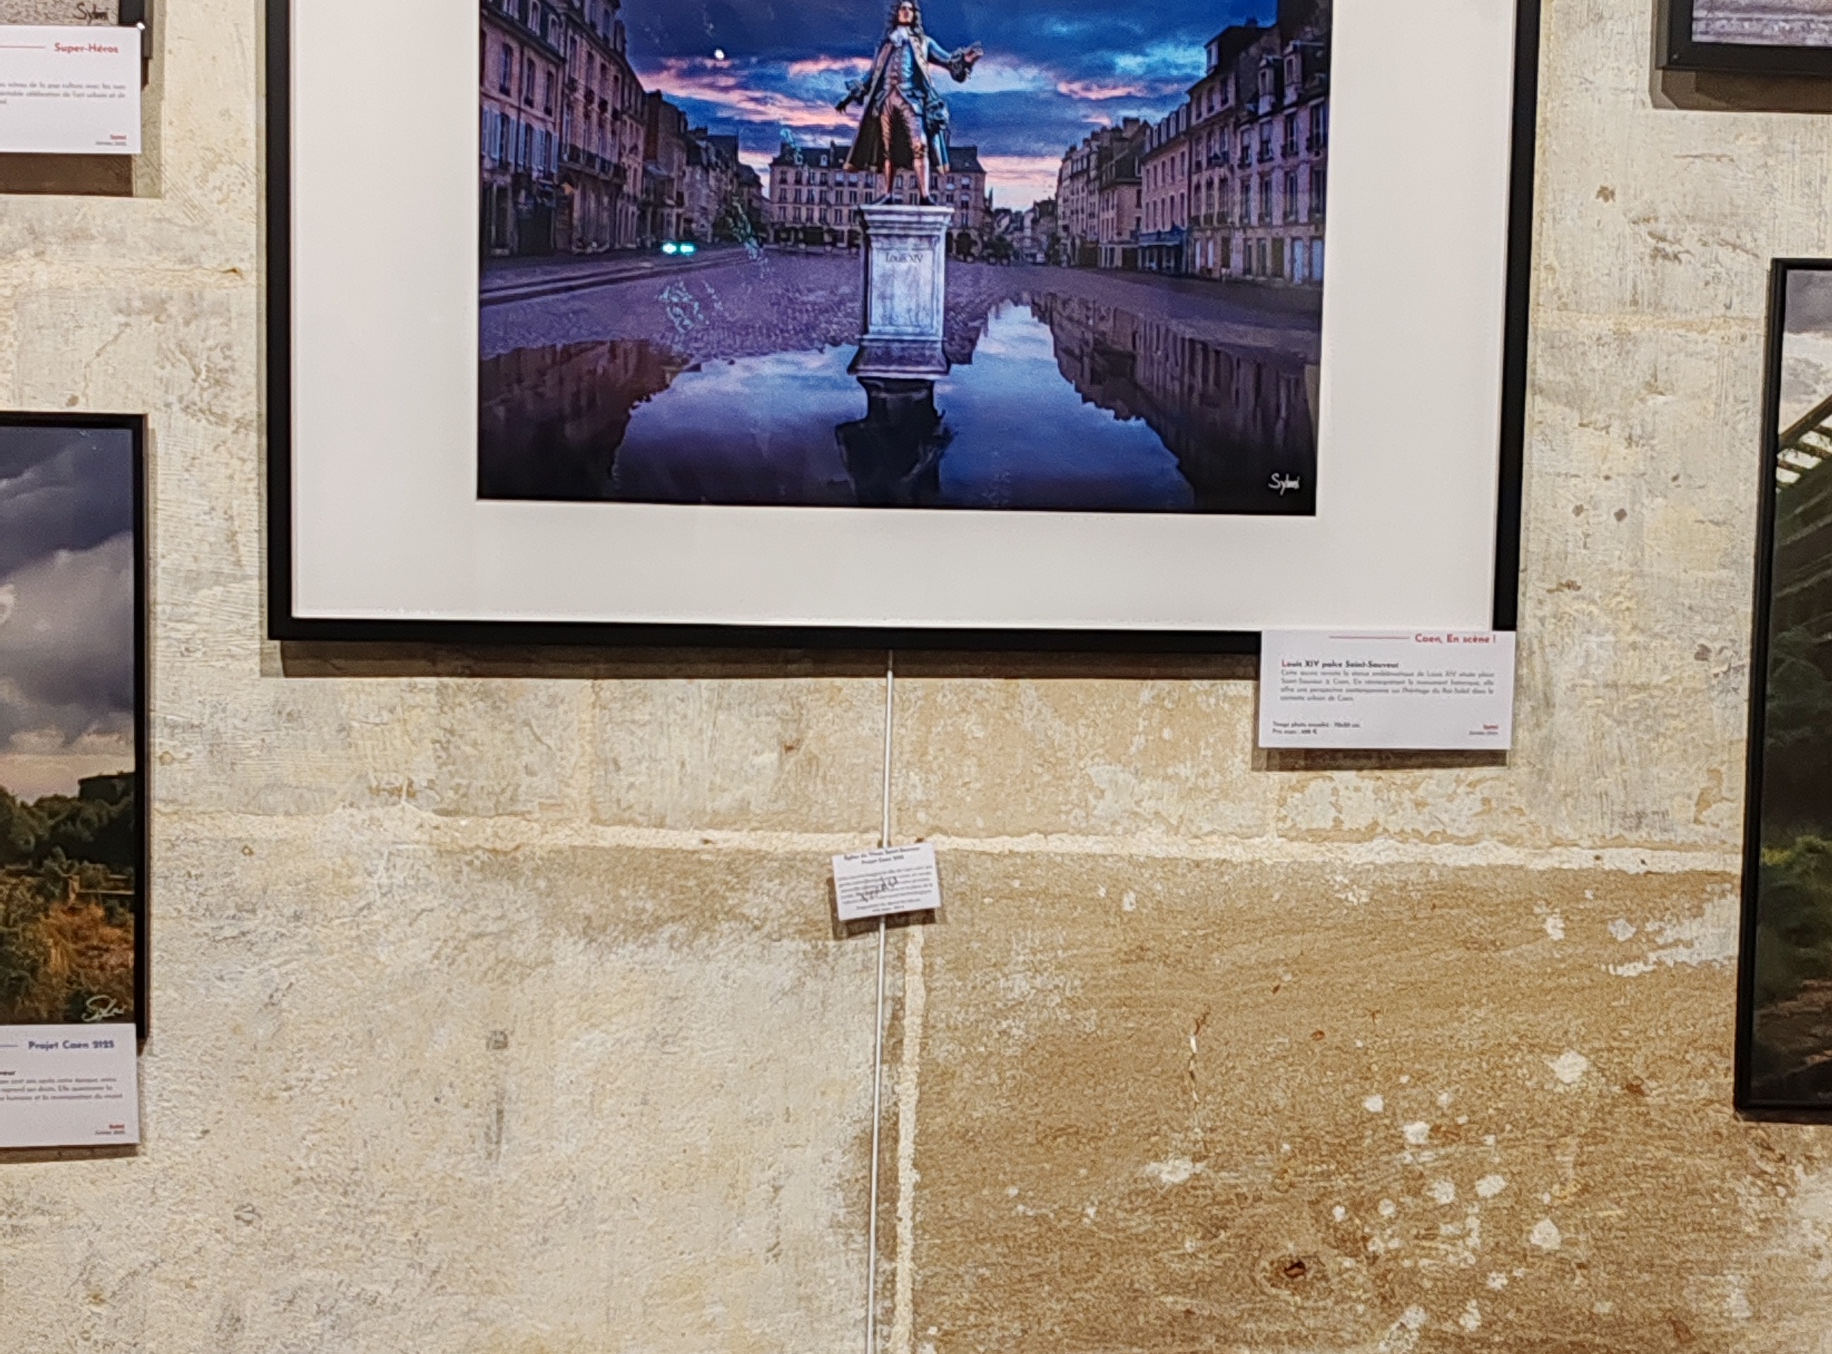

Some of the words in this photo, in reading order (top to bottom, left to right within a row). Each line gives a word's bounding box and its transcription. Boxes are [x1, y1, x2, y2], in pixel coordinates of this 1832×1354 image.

[1446, 634, 1460, 643] En
[1281, 658, 1302, 667] Louis
[1304, 659, 1319, 668] XIV
[28, 1040, 59, 1052] Projet
[62, 1039, 89, 1050] Caen
